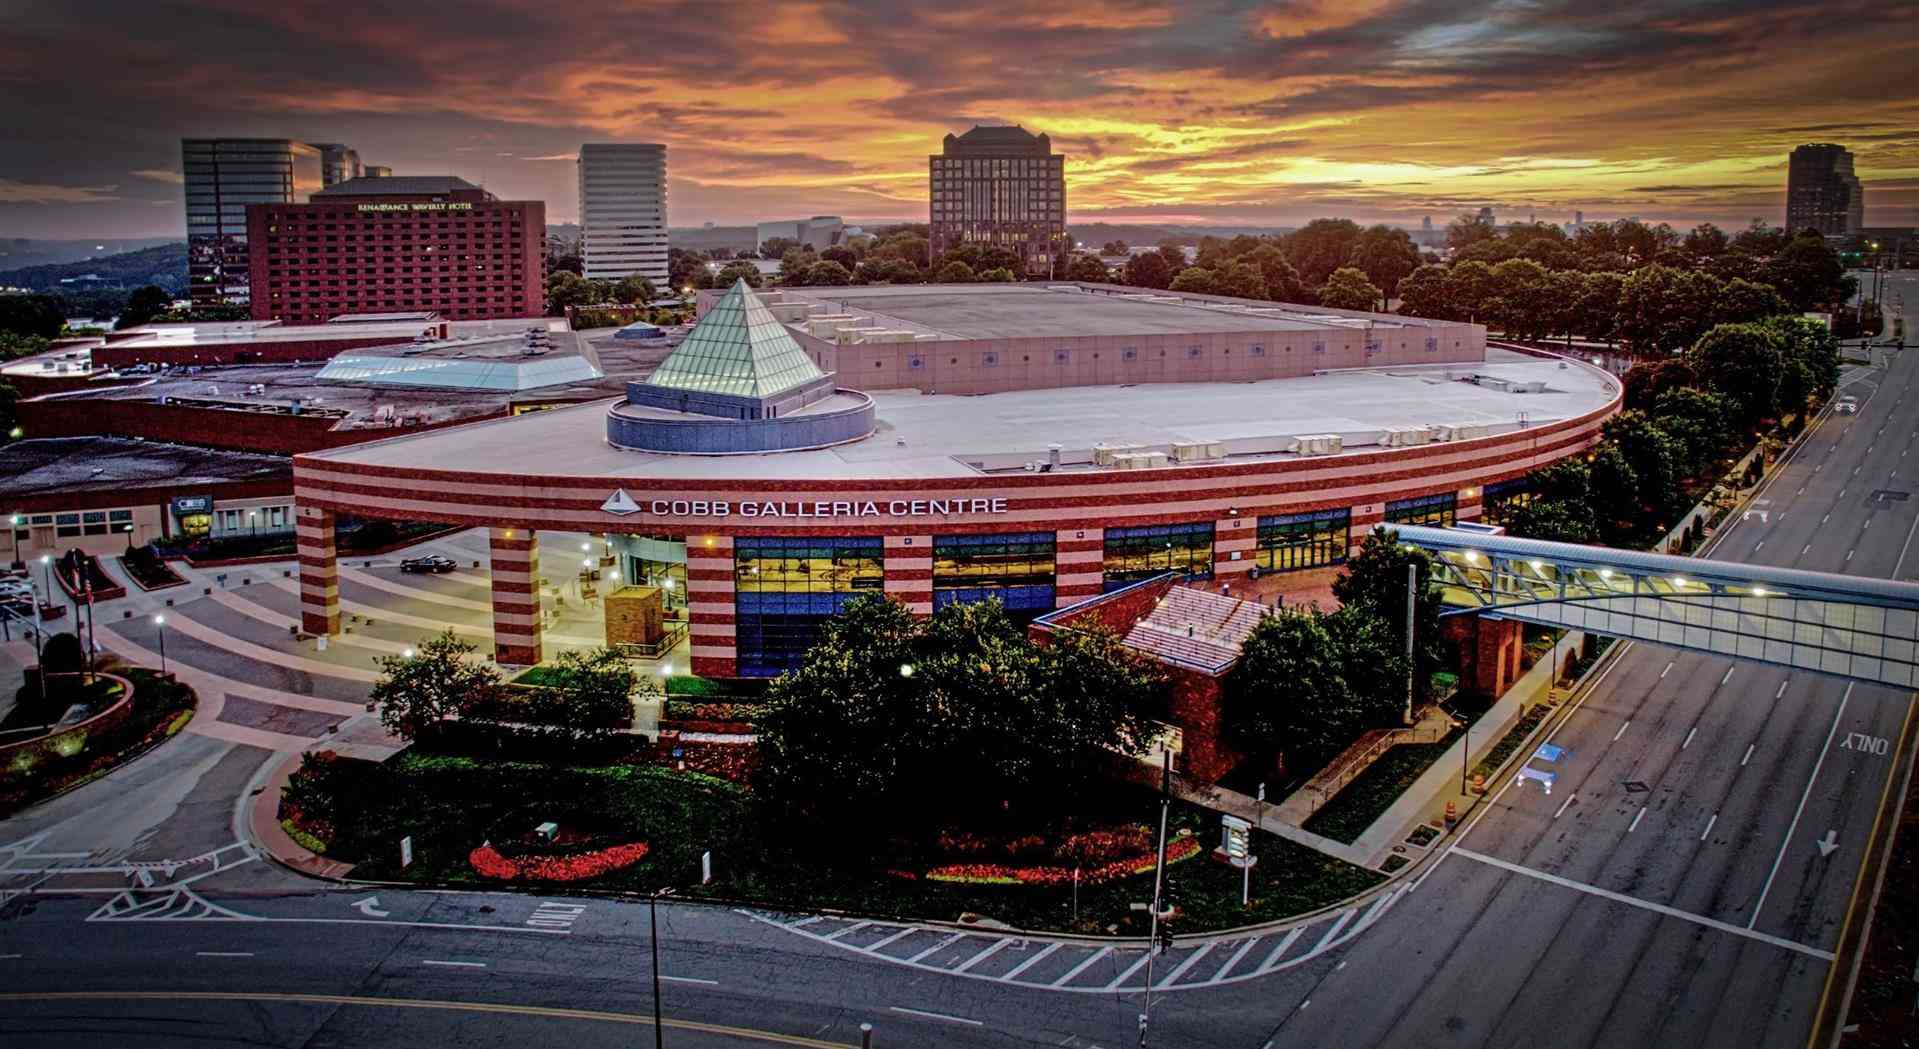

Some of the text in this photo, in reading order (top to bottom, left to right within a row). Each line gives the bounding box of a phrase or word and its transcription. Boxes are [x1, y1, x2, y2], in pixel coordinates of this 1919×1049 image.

[651, 497, 1008, 517] COBB GALLERIA CENTRE
[1840, 731, 1889, 756] ONLY
[526, 901, 587, 927] ONLY
